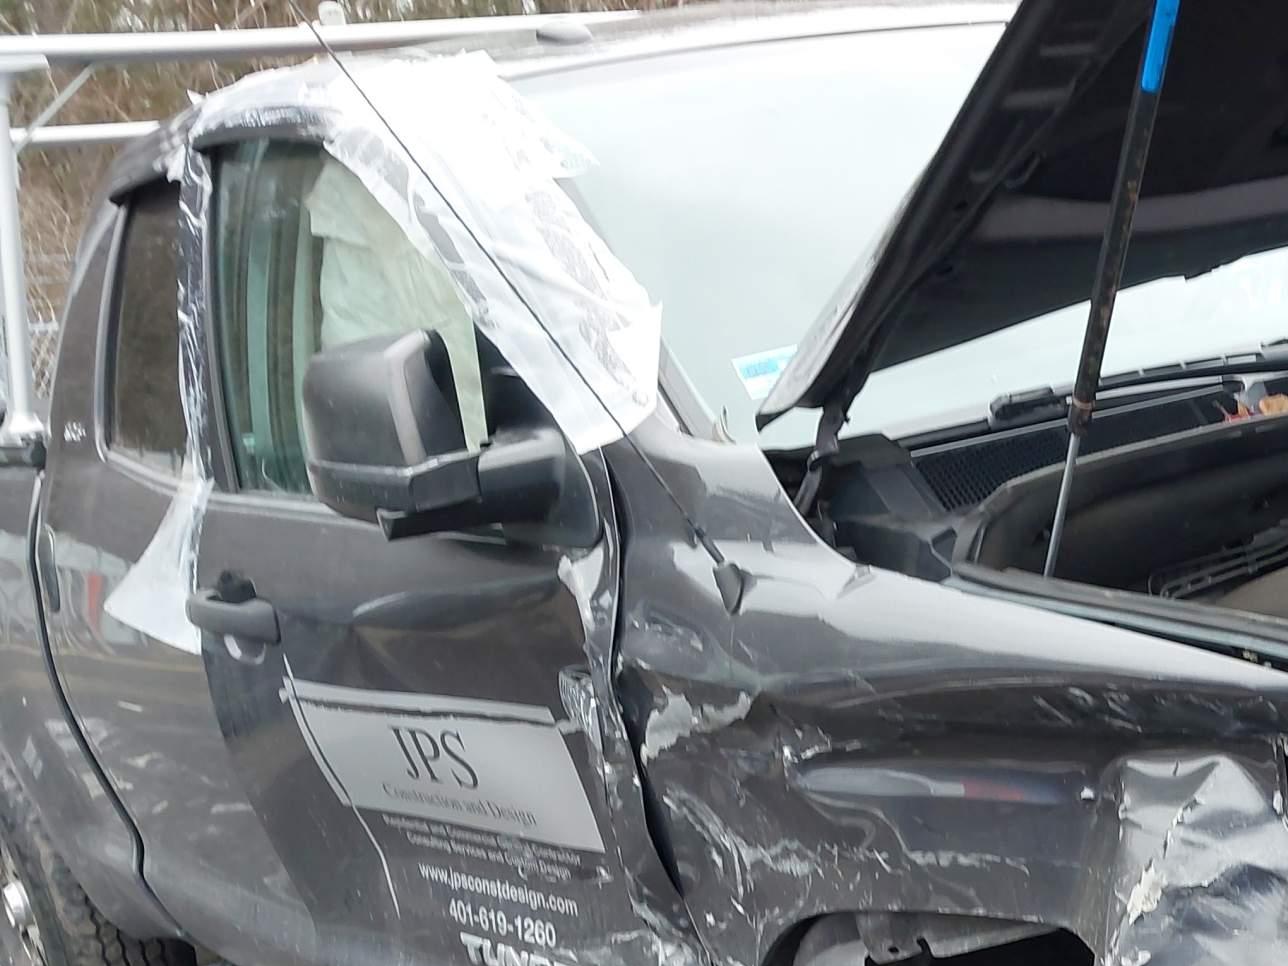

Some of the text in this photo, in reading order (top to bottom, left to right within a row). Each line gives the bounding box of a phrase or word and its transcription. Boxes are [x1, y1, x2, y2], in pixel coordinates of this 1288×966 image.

[388, 724, 479, 789] JPS
[486, 800, 537, 829] Design
[418, 863, 579, 917] www.jpsconstdesign.com
[449, 897, 557, 949] 401-619-1260
